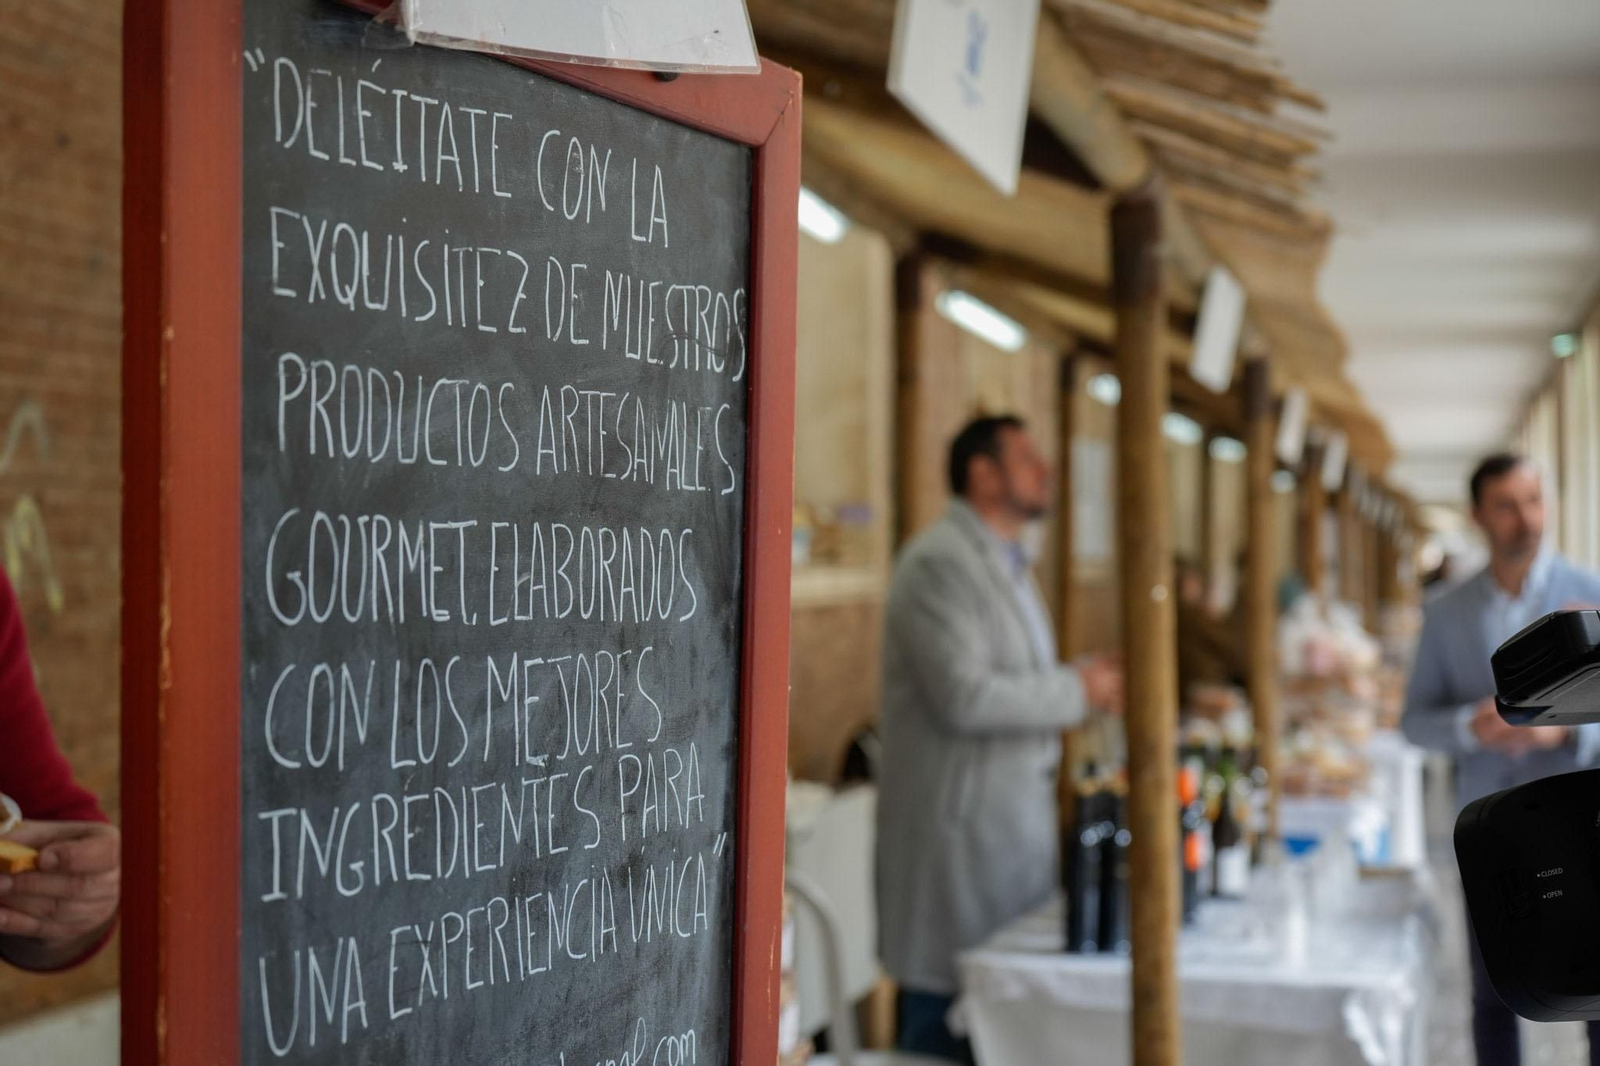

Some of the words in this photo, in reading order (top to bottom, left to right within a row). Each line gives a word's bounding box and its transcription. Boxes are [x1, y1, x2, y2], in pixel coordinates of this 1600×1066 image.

[537, 129, 612, 224] CON
[631, 157, 669, 249] LA
[546, 255, 590, 345] DE
[602, 269, 746, 383] NUESTROS
[277, 352, 520, 472] PRODUCTOS
[536, 384, 736, 496] ARTESANALES
[489, 521, 699, 626] ELABORADOS
[265, 658, 376, 772] CON
[390, 655, 469, 769] LOS
[484, 646, 662, 768] MEJORES
[257, 764, 602, 903] INGREDIENTES
[618, 742, 706, 841] PARA
[1540, 867, 1564, 878] CLOSED
[1546, 889, 1563, 899] OPEN
[259, 936, 369, 1057] UNA
[389, 863, 618, 1021] EXPERIENCIA
